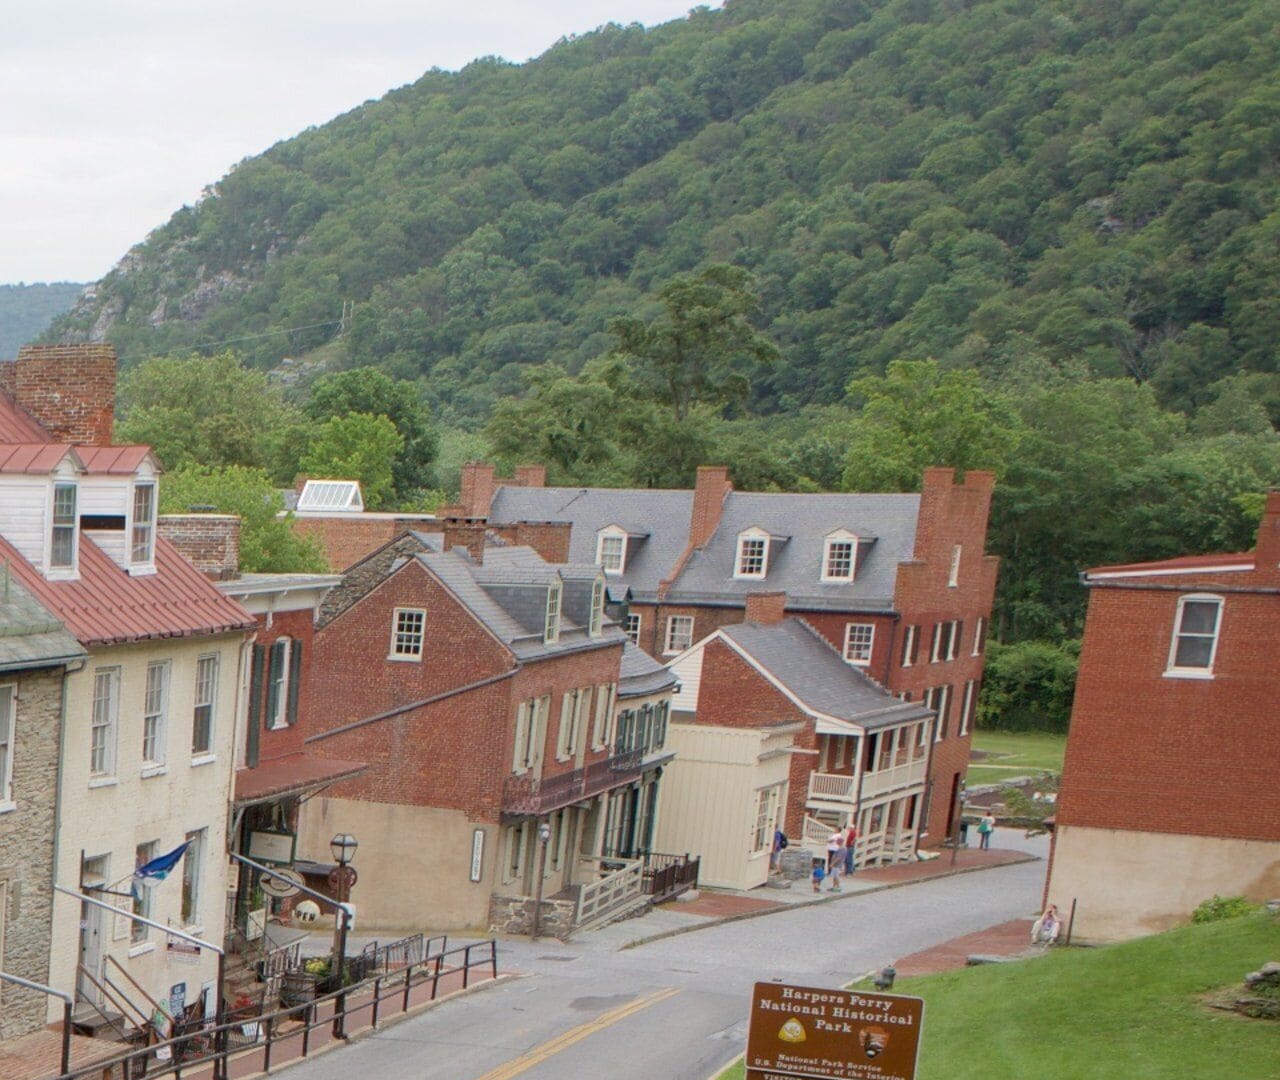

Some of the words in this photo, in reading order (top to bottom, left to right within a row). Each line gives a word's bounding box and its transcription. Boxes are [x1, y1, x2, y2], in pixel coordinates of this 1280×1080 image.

[782, 988, 844, 1003] Harpers
[850, 995, 893, 1011] Ferry
[760, 999, 825, 1016] National
[832, 1007, 913, 1025] Historical
[815, 1019, 852, 1032] Park
[755, 1058, 771, 1066] U.S.
[776, 1061, 831, 1074] Department
[847, 1070, 863, 1078] the
[778, 1054, 818, 1065] National
[822, 1058, 844, 1067] Park
[847, 1062, 882, 1072] Service
